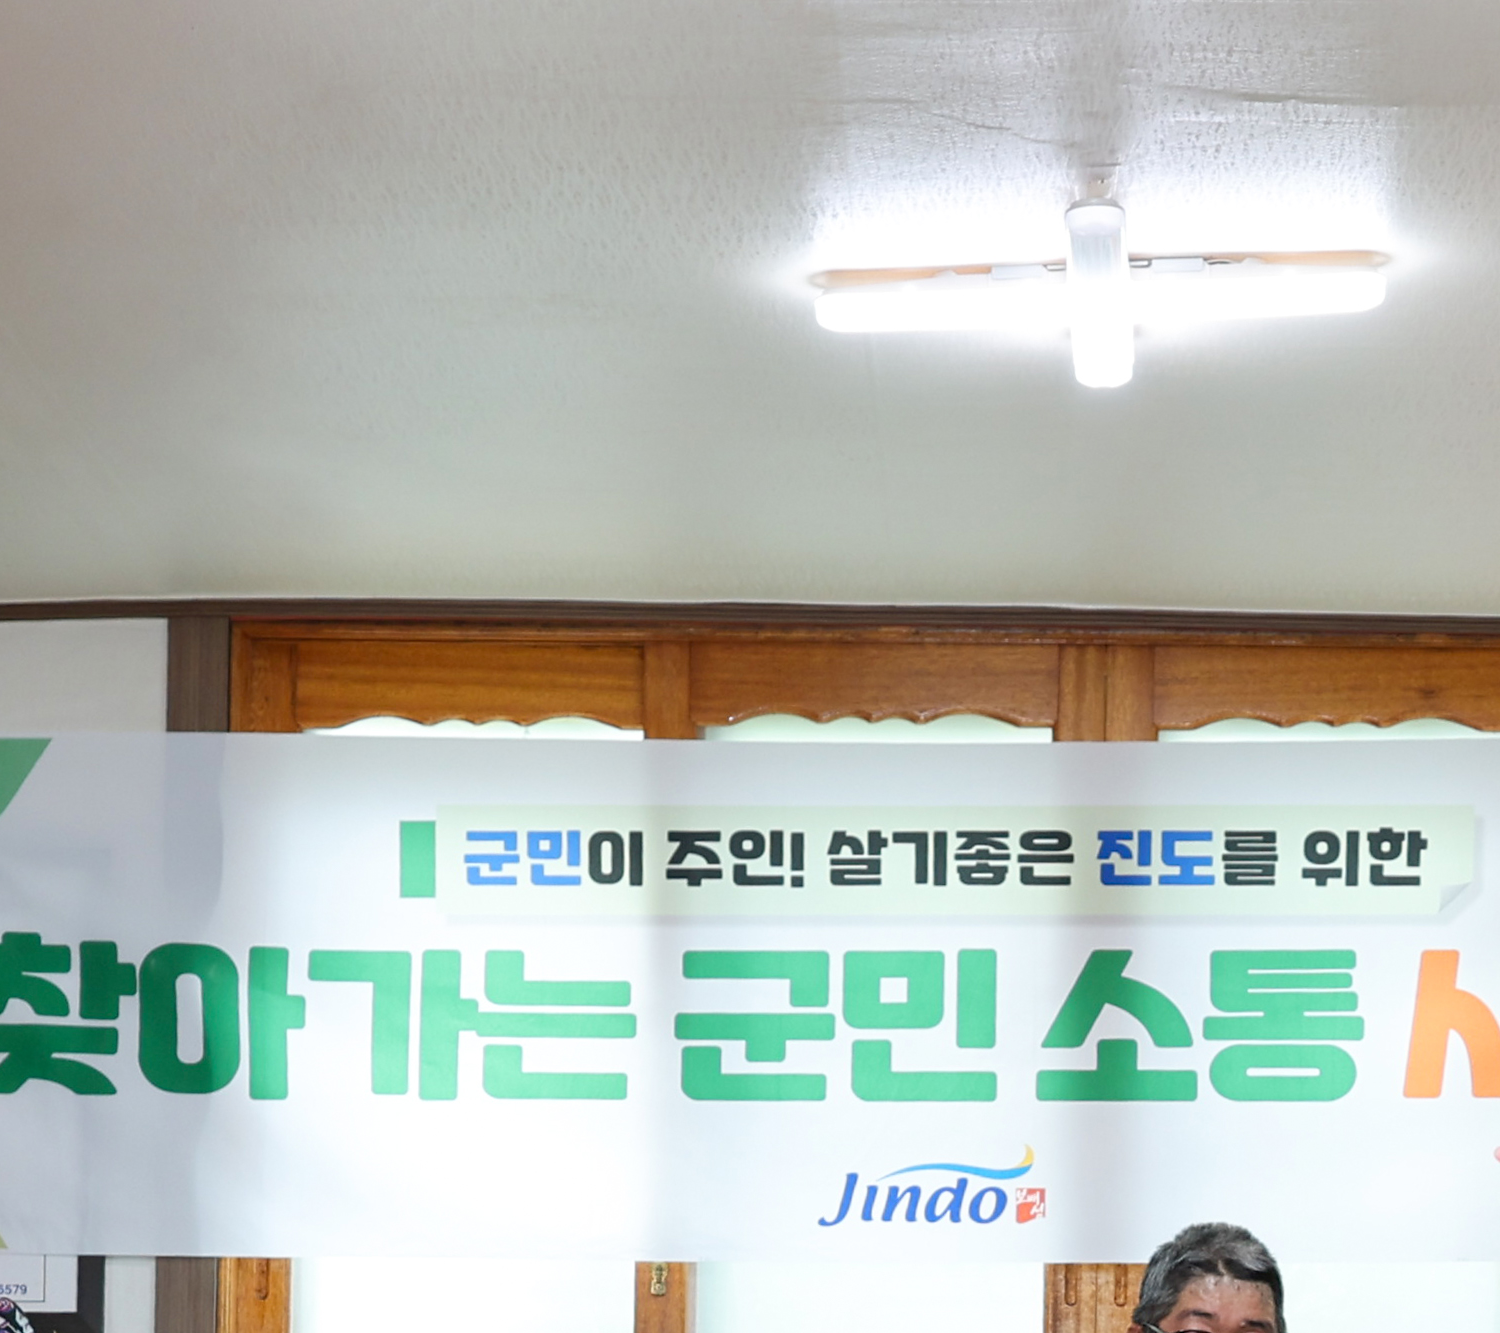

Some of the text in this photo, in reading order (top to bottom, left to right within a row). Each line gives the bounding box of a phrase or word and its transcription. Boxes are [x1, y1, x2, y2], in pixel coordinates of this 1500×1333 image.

[464, 827, 1428, 888] 군민이 주인! 살기좋은 진도를 위한
[674, 948, 998, 1103] 군민
[1036, 949, 1365, 1103] 소통
[818, 1172, 1008, 1226] Jindo
